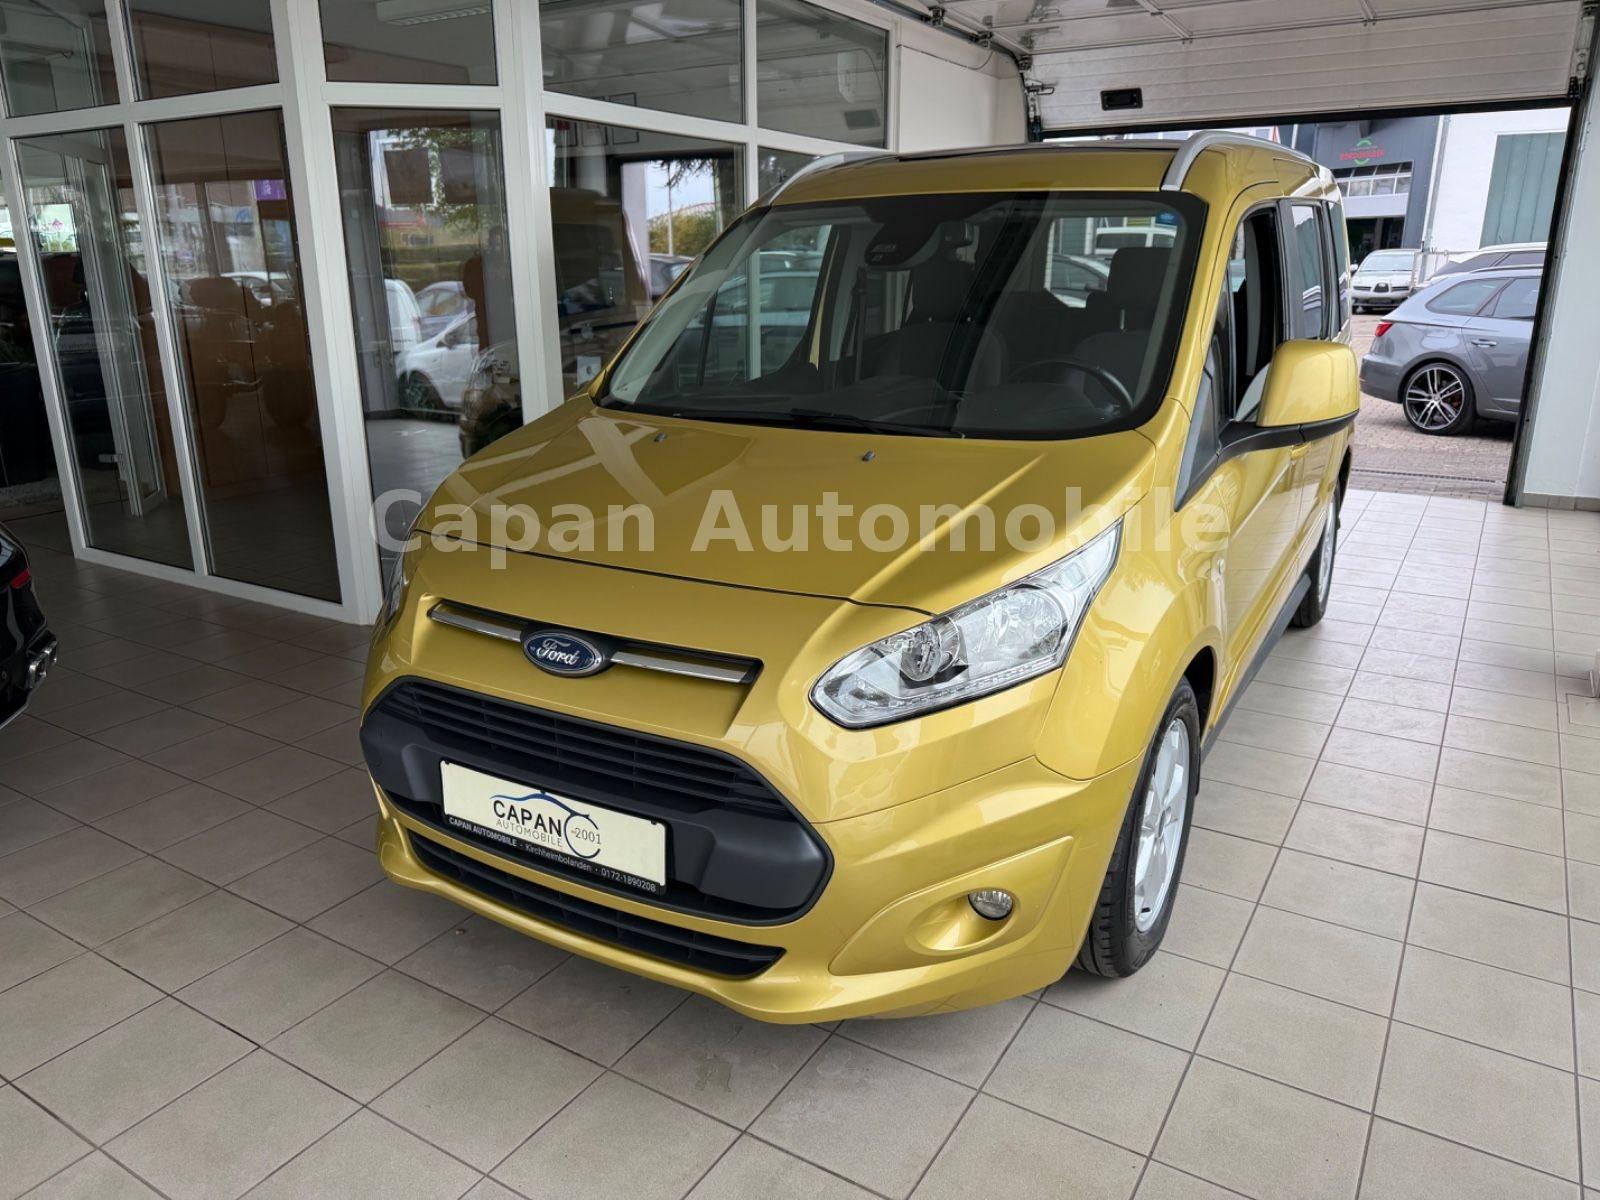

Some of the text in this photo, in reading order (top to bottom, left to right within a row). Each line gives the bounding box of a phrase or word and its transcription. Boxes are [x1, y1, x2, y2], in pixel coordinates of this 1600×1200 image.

[536, 638, 580, 665] Ford
[493, 800, 562, 837] CAPAN
[496, 818, 563, 847] AUTOMOBILE
[448, 817, 472, 831] CAPAN
[473, 825, 518, 847] AUTOMOBILE
[601, 867, 657, 893] 0172-1890208
